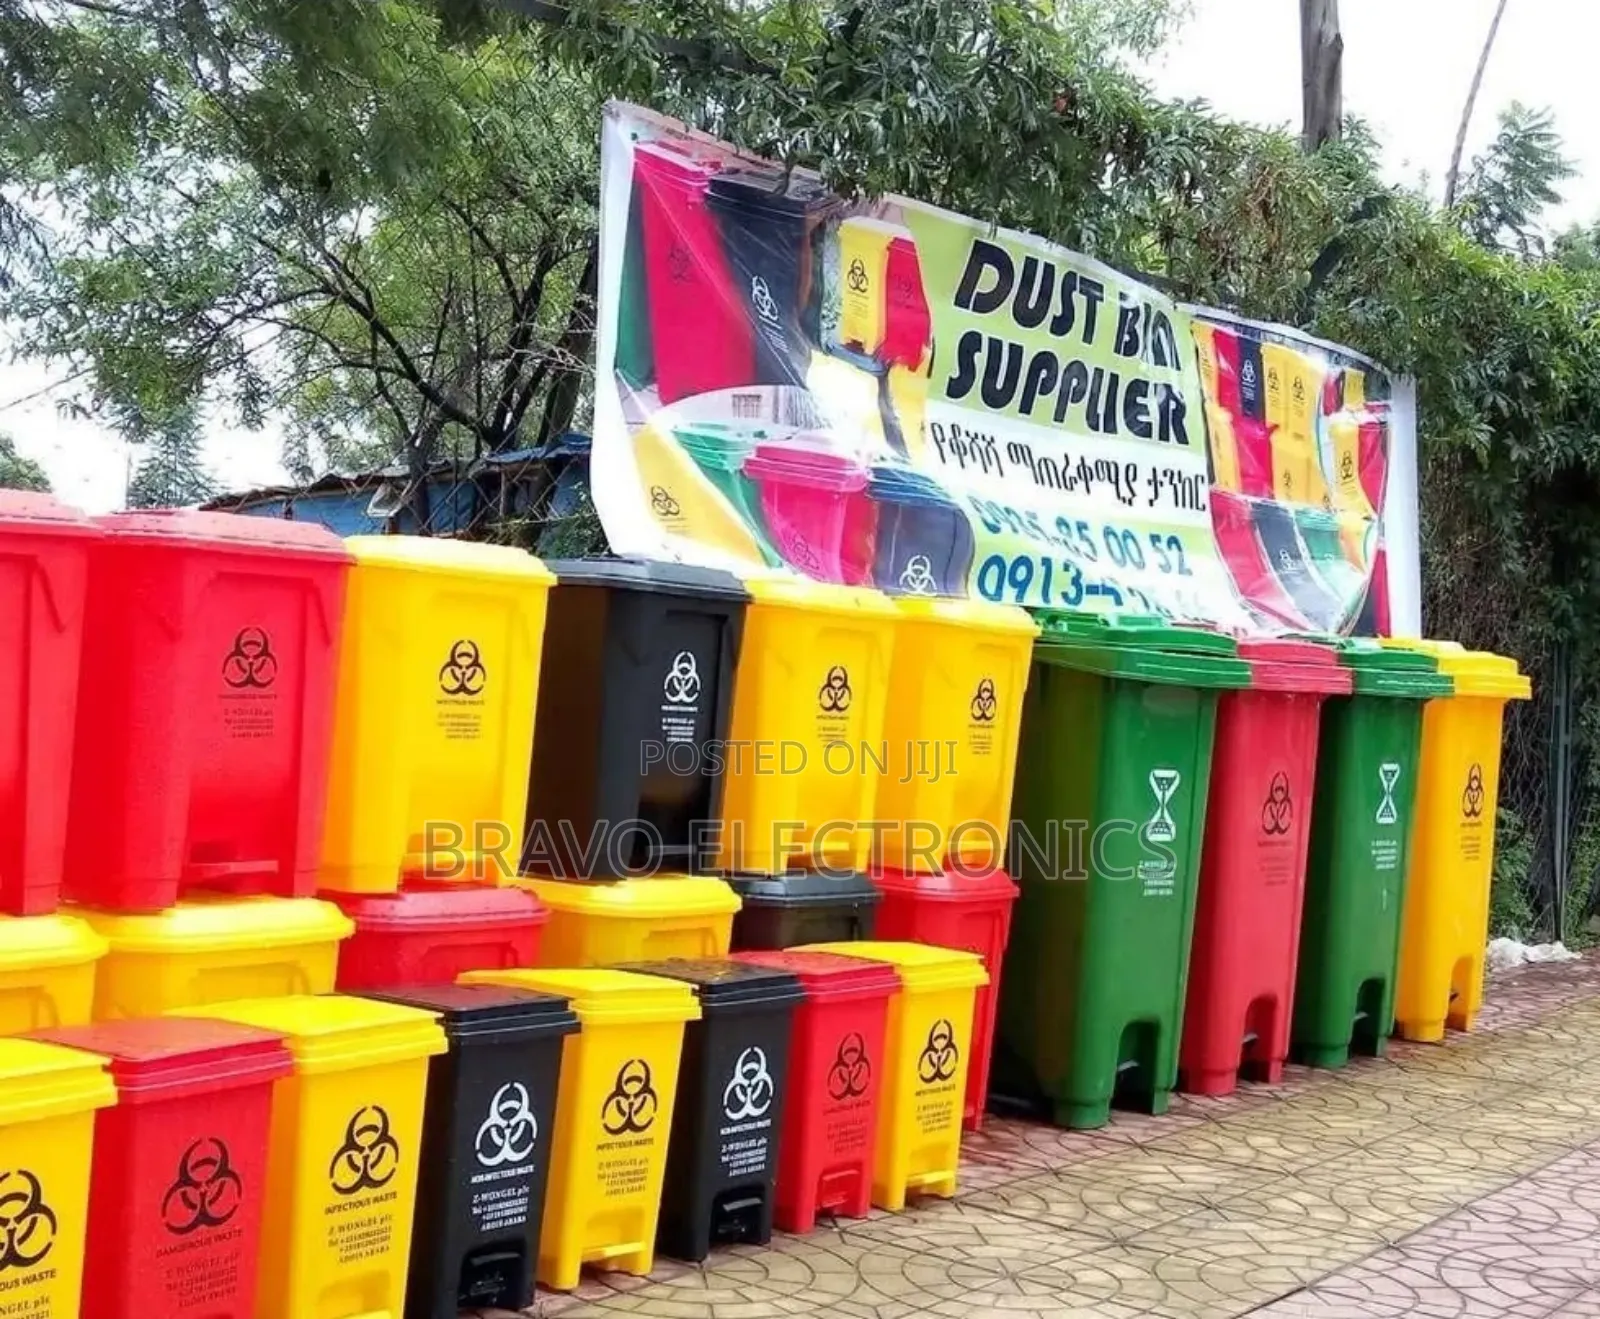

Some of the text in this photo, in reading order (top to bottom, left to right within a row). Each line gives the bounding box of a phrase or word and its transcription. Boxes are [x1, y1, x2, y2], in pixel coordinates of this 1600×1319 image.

[954, 238, 1181, 371] DUST BIN
[945, 330, 1190, 445] SUPPLIER
[931, 421, 1004, 478] የቆሻሻ
[22, 1268, 57, 1287] WASTE
